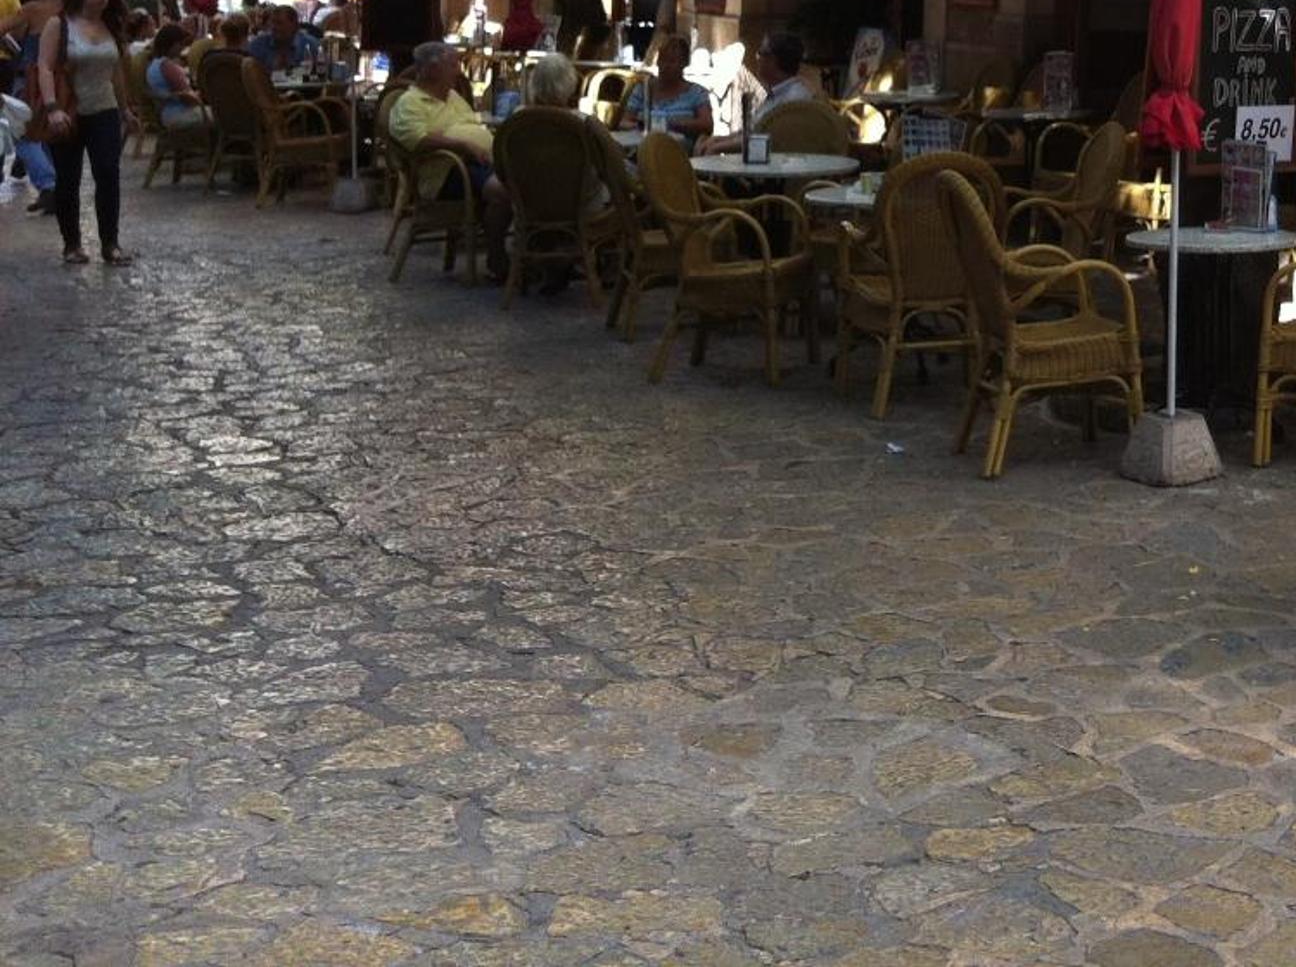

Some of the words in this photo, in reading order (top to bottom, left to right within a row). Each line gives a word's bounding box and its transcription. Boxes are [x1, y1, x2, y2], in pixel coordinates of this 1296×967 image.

[1212, 6, 1291, 52] PIZZA
[1236, 56, 1266, 74] AND
[1212, 73, 1278, 107] DRINK
